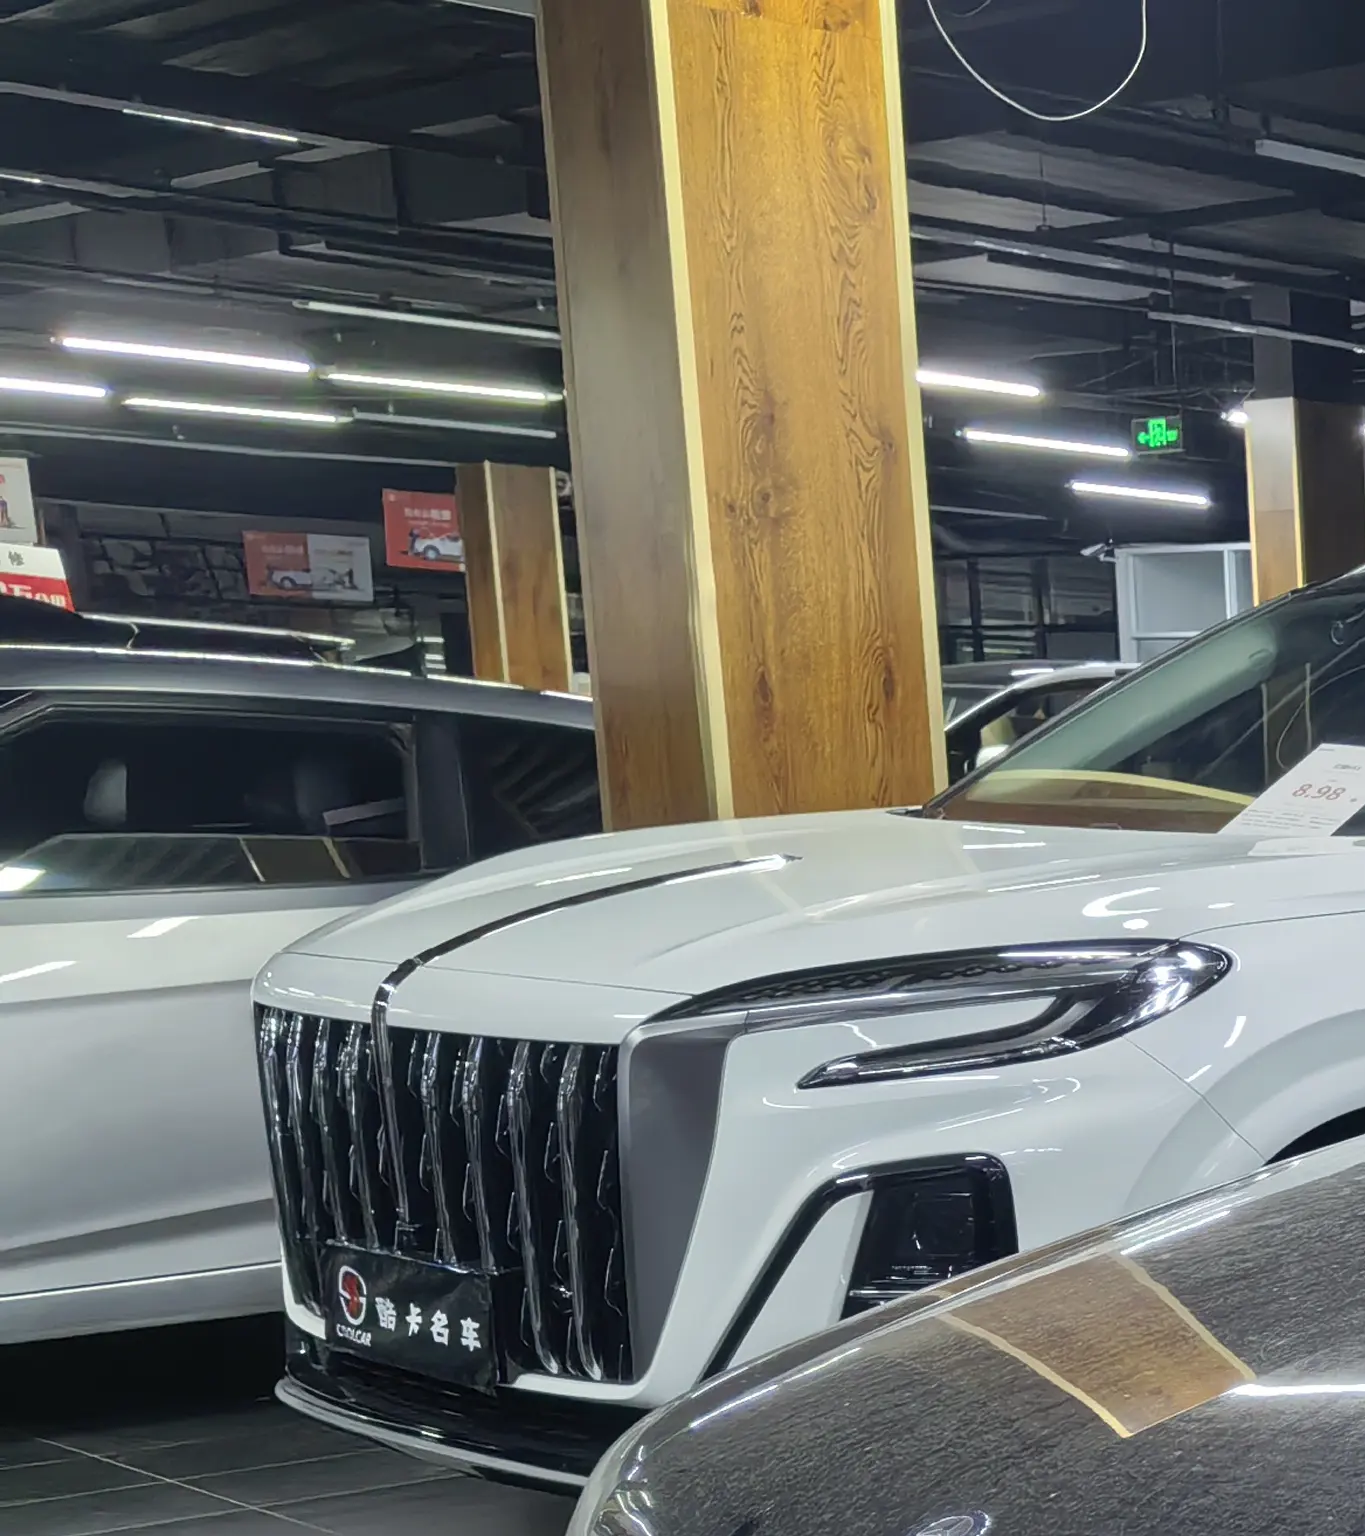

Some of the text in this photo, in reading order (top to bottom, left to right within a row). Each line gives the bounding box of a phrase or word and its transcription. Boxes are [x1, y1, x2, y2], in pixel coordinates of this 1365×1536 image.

[1292, 783, 1346, 801] 8.98
[375, 1297, 482, 1352] 酷卡名车
